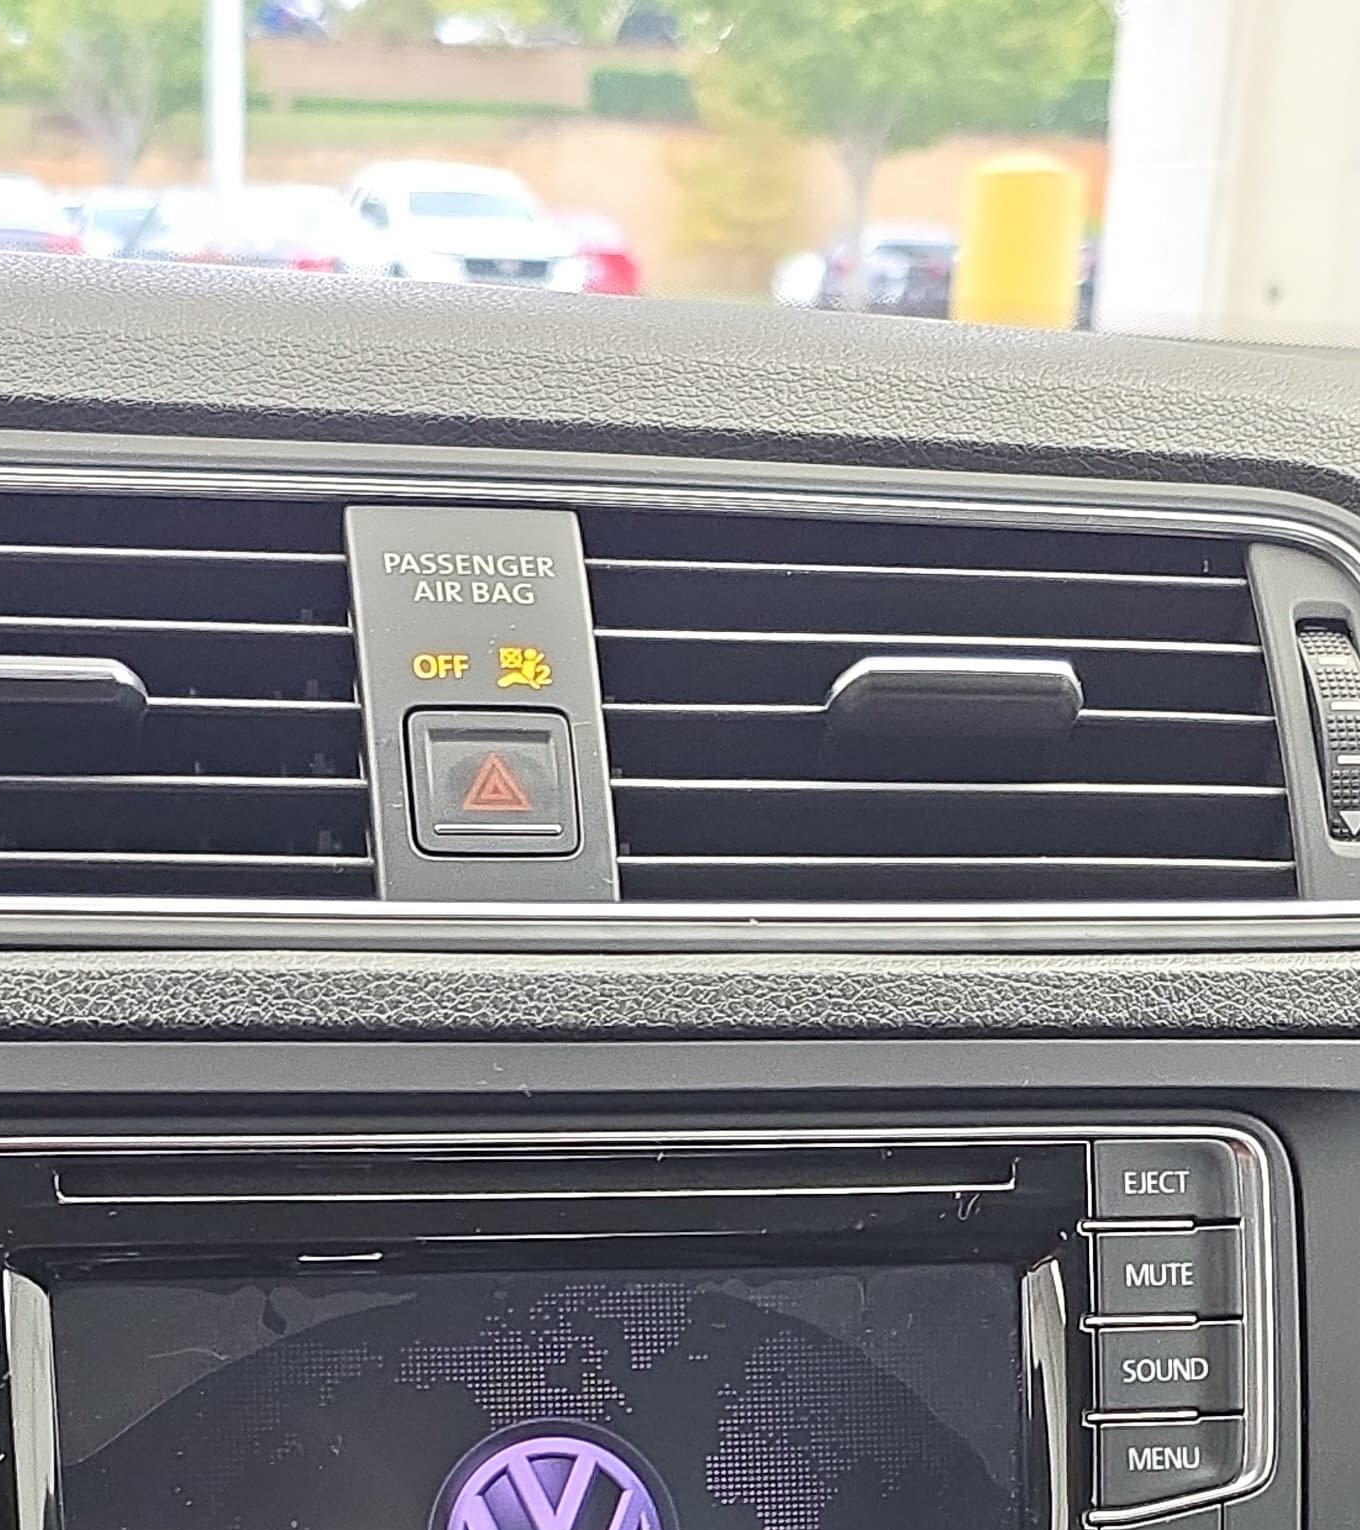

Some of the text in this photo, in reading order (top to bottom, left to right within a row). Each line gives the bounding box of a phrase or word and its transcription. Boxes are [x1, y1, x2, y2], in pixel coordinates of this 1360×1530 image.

[383, 553, 555, 577] PASSENGER
[414, 581, 534, 604] AIR BAG
[412, 654, 469, 679] OFF
[1124, 1170, 1190, 1195] EJECT
[1125, 1262, 1194, 1287] MUTE
[1122, 1357, 1209, 1383] SOUND
[1128, 1446, 1201, 1471] MENU
